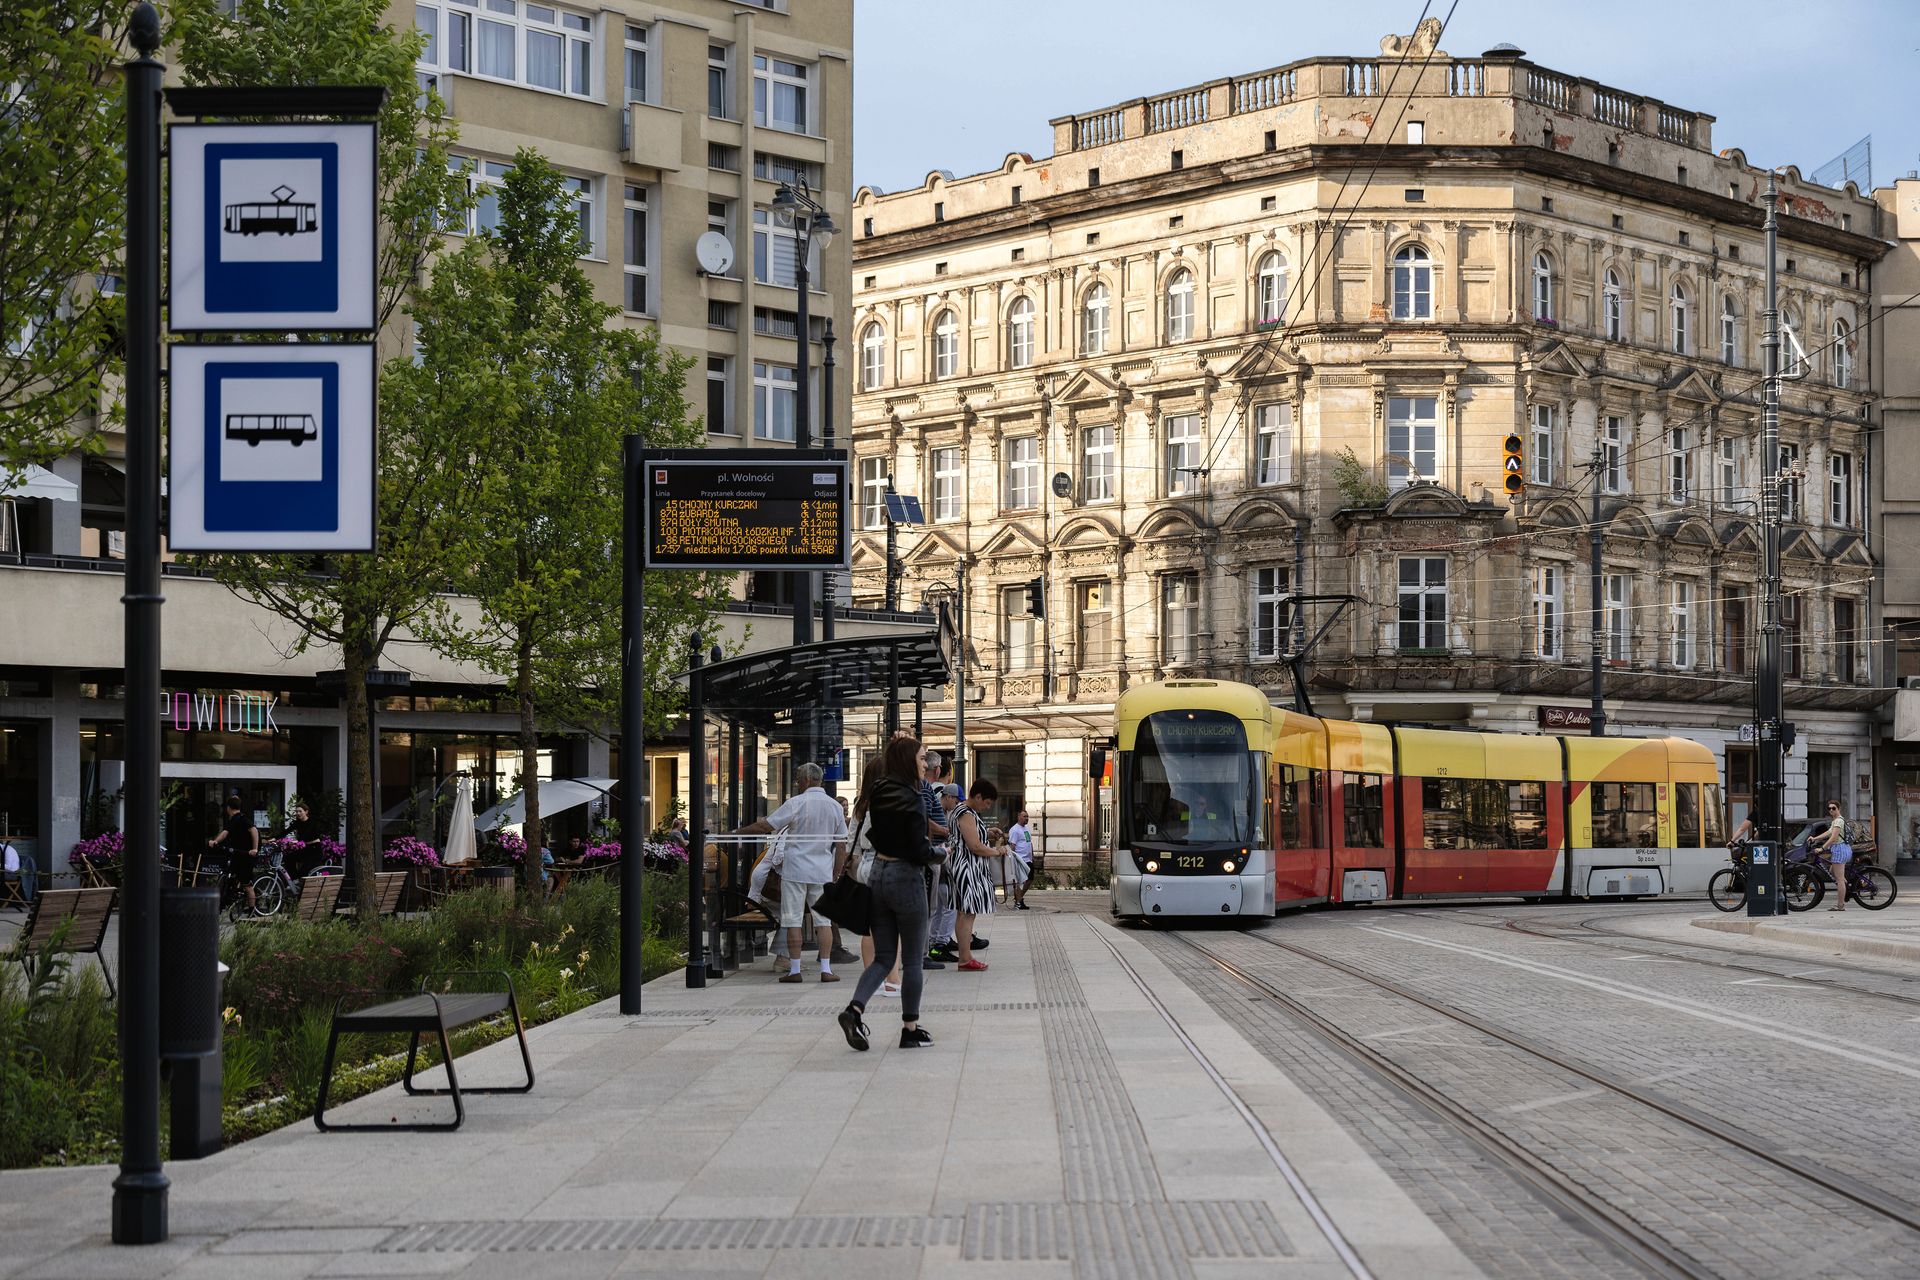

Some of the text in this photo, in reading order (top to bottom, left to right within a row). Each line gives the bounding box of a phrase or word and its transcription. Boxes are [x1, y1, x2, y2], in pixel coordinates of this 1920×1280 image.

[718, 472, 774, 483] pl. Wolności
[701, 490, 734, 498] Przystanek
[735, 490, 766, 498] docelowy
[814, 490, 837, 498] Odjazd
[666, 500, 678, 509] 15
[679, 500, 713, 509] CHOJNY
[715, 500, 758, 509] KURCZAKI
[660, 509, 678, 518] 87A
[815, 509, 837, 518] 6min
[660, 518, 837, 527] 87A DOŁY SMUTNA 12min
[660, 527, 678, 536] 100
[682, 527, 743, 536] PIOTRKOWSKA
[810, 527, 837, 536] 14min
[666, 536, 678, 545] 86
[679, 536, 718, 545] RETKINIA
[810, 536, 837, 545] 16min
[656, 545, 680, 554] 17:57
[732, 545, 758, 554] 17.06
[760, 545, 788, 555] powrót
[791, 545, 809, 554] linii
[160, 692, 280, 733] POWIDOK
[1436, 767, 1448, 775] 1212
[1177, 856, 1205, 868] 1212
